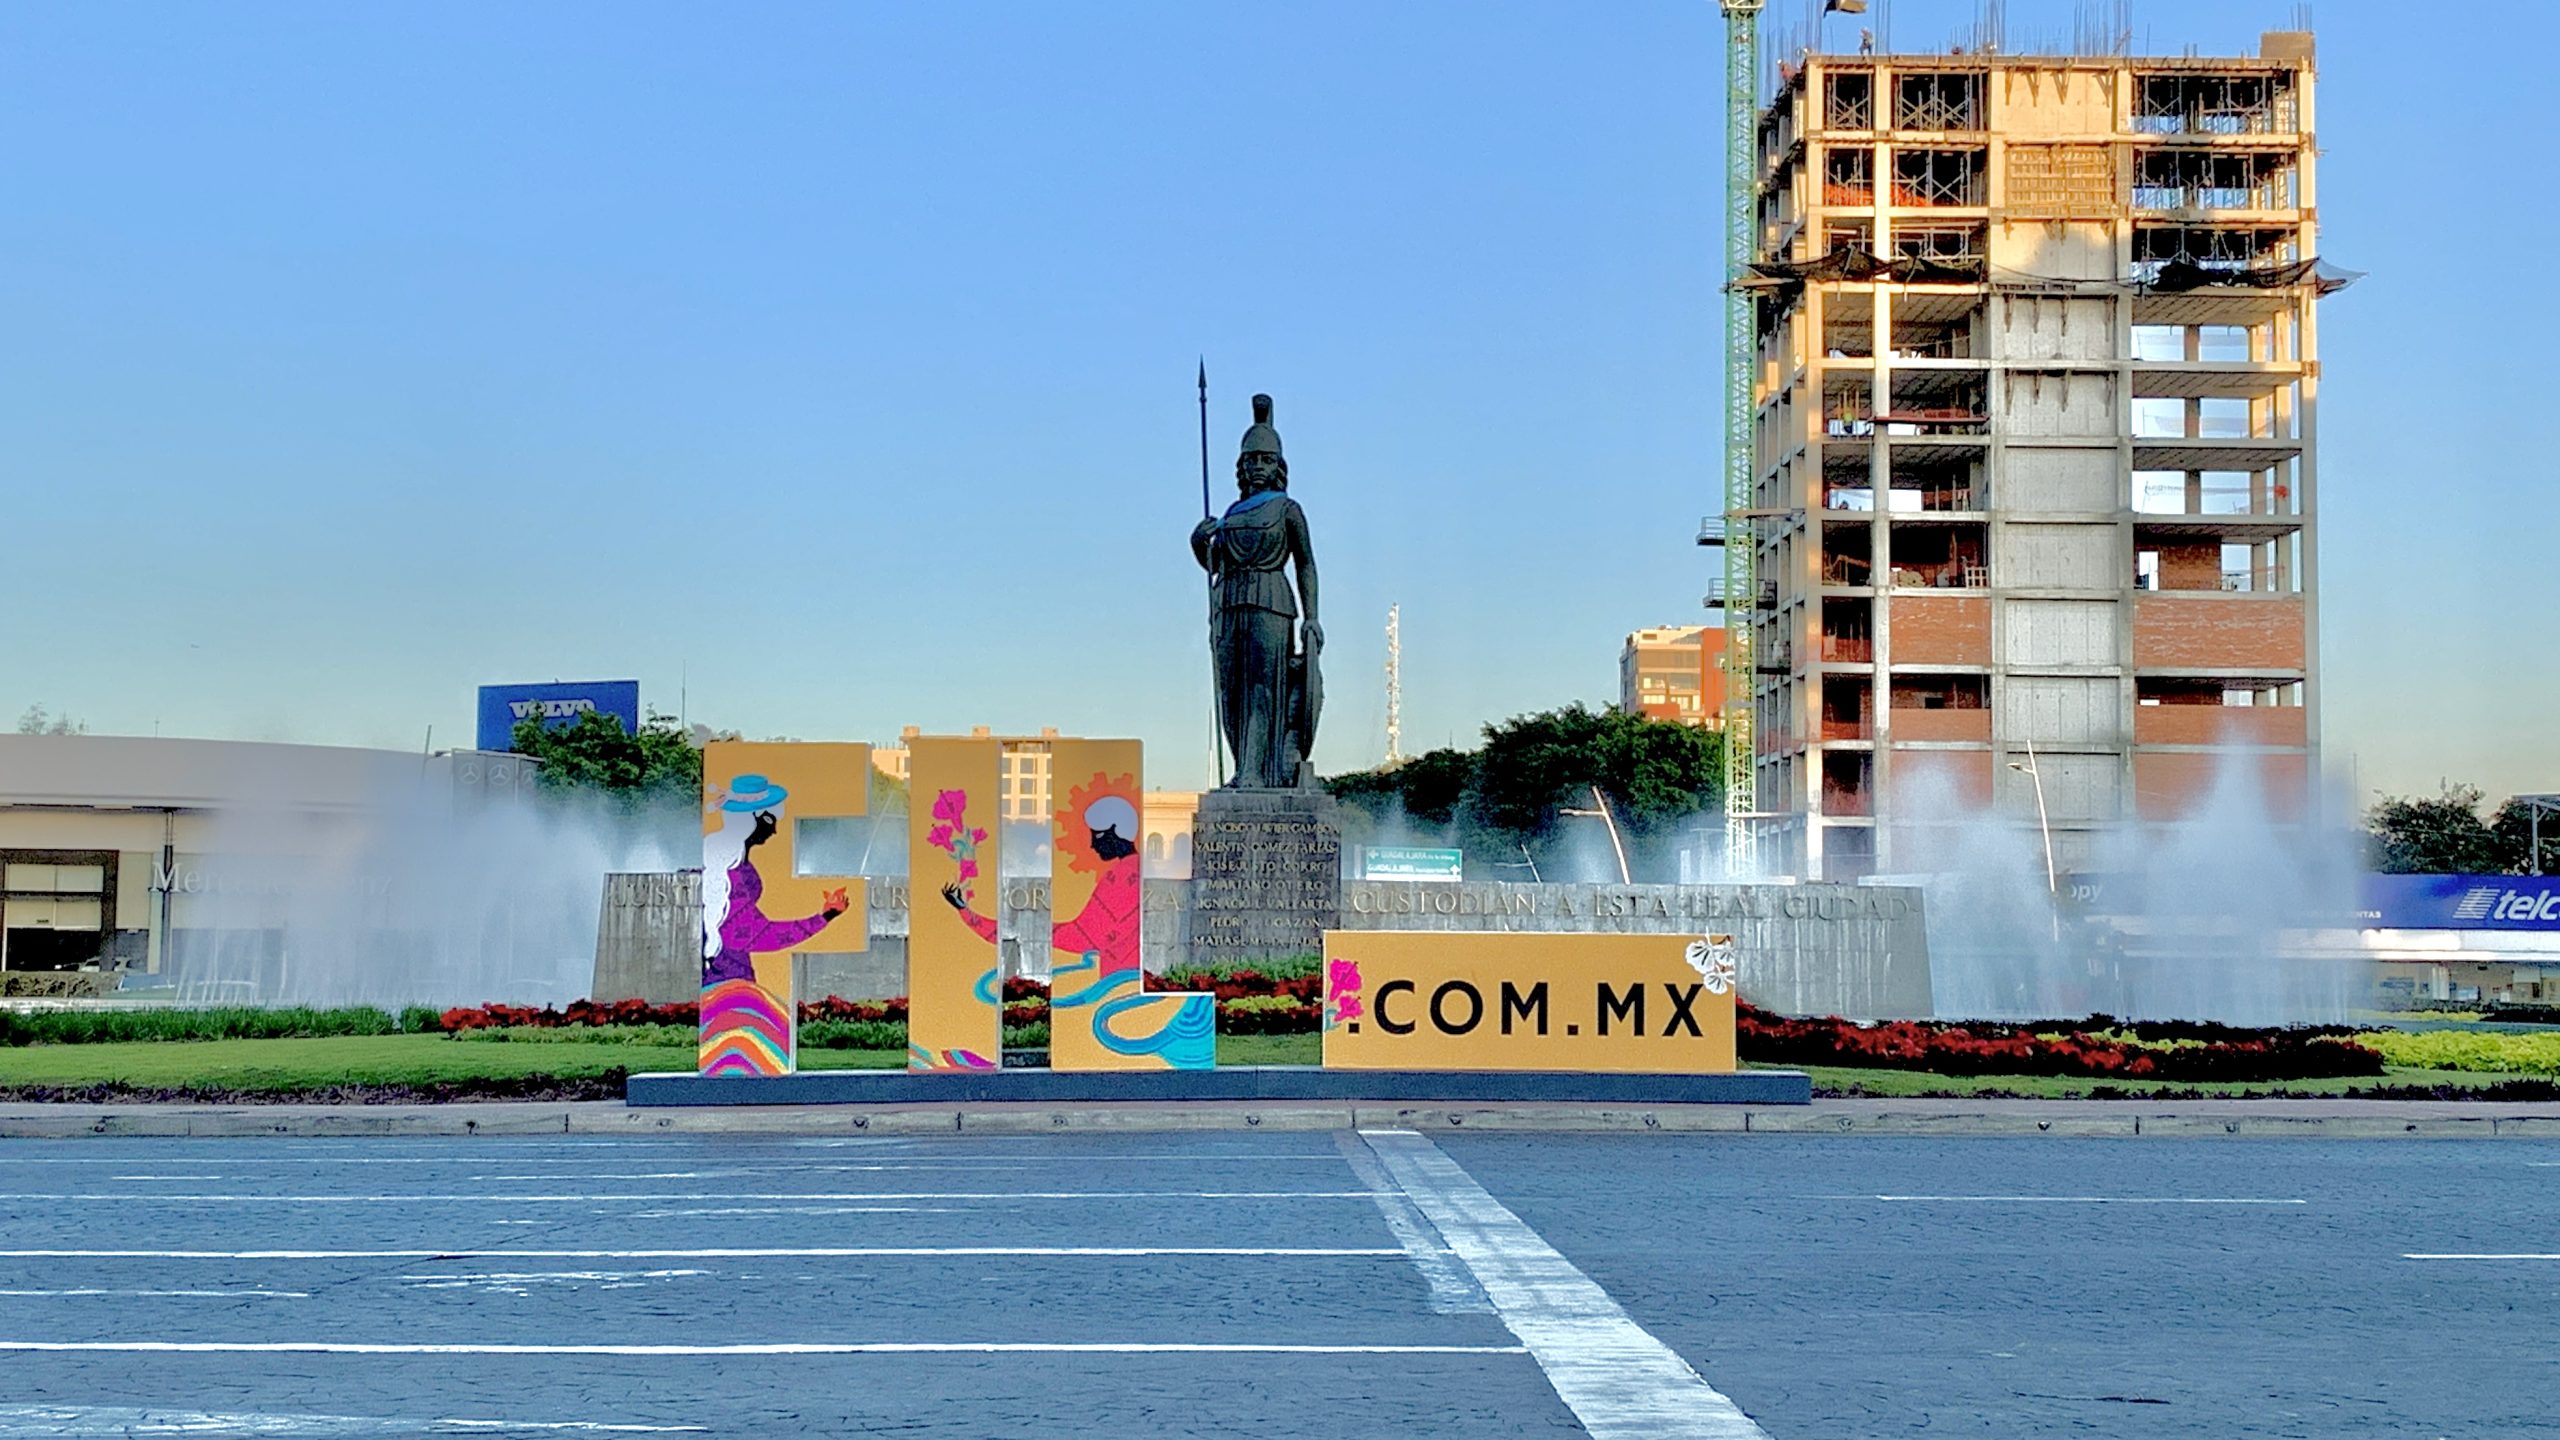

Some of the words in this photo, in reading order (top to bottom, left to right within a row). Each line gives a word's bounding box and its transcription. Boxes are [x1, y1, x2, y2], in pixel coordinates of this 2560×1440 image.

[508, 699, 595, 718] VOLVO
[1275, 880, 1324, 891] OTERO
[1353, 889, 1536, 915] CUSTODIAN
[1557, 894, 1576, 917] A
[1594, 893, 1670, 918] ESTA
[2493, 889, 2560, 921] telc
[1348, 980, 1704, 1037] .COM.MX
